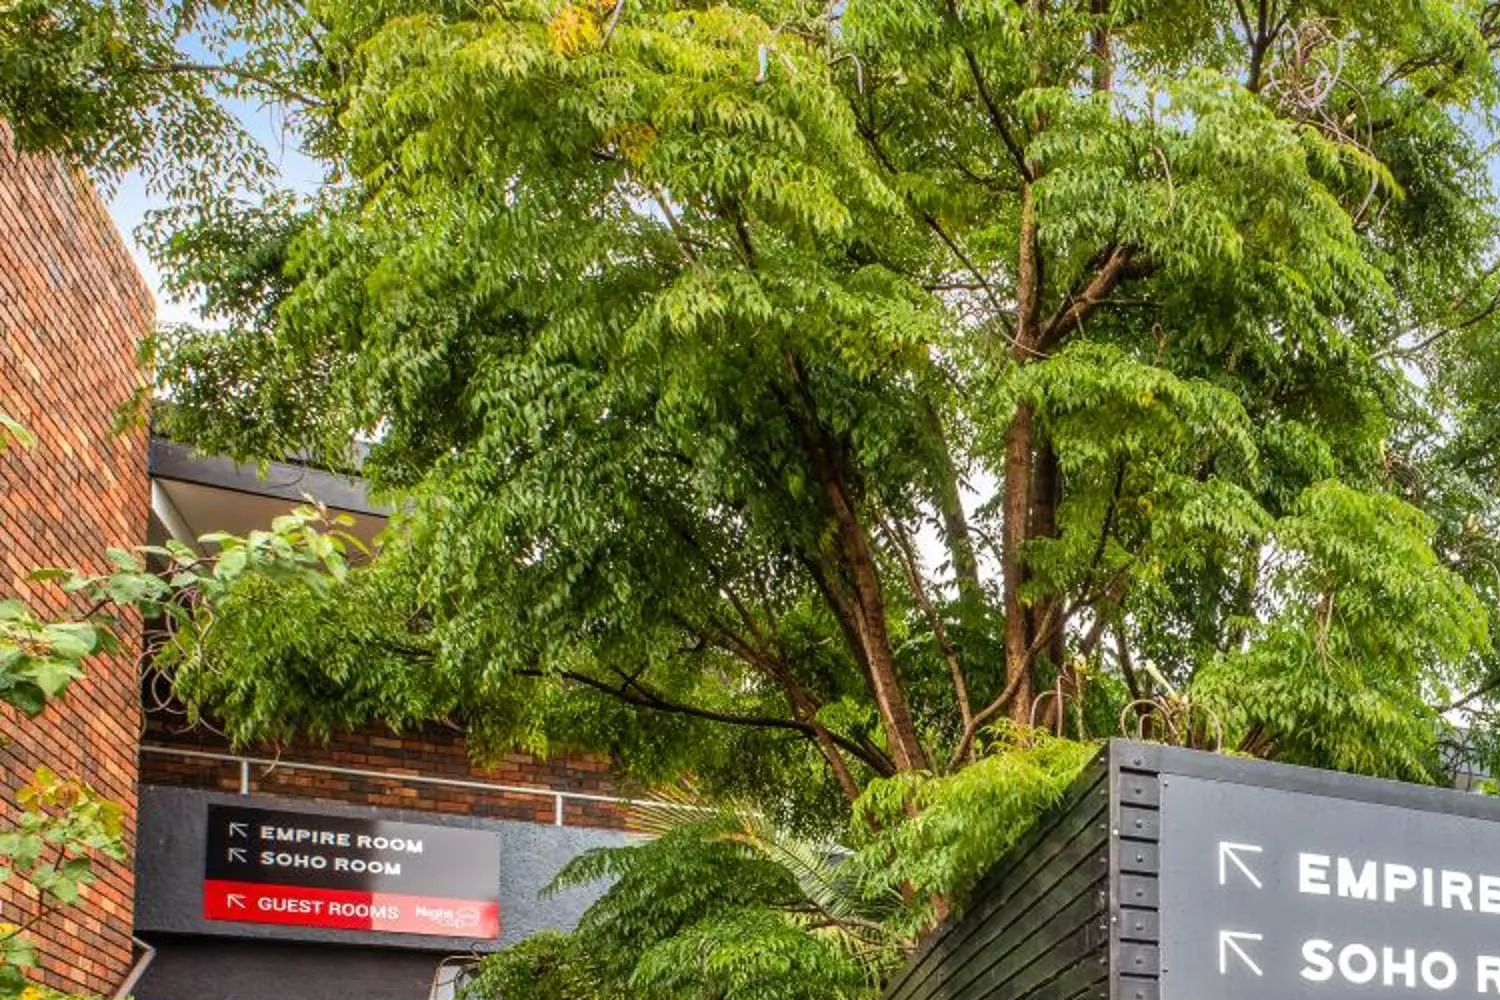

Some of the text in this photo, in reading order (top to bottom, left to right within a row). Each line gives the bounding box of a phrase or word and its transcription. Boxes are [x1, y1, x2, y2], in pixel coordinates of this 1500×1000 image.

[260, 825, 423, 853] EMPIRE ROOM
[260, 850, 401, 875] SOHO ROOM
[257, 896, 399, 919] GUEST ROOMS
[1299, 938, 1457, 990] SOHO
